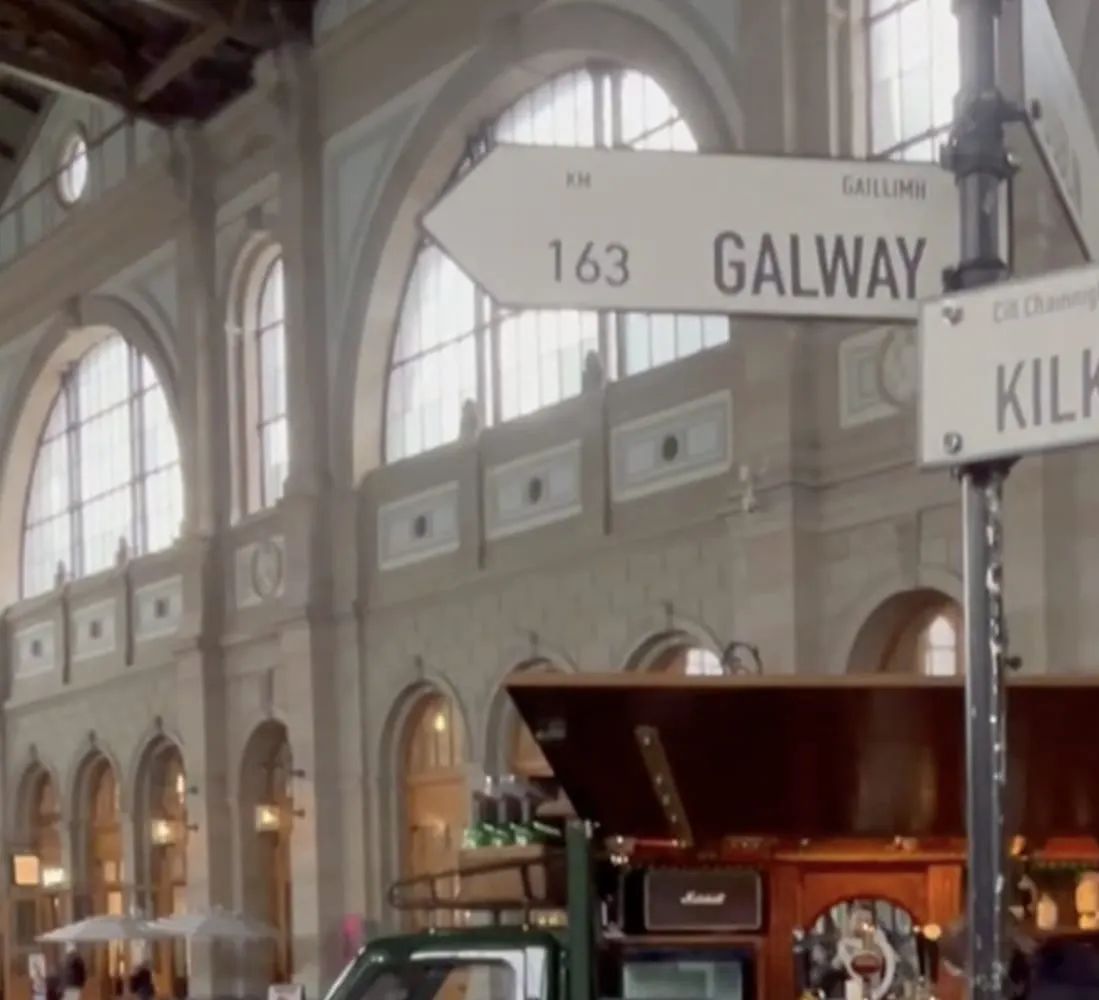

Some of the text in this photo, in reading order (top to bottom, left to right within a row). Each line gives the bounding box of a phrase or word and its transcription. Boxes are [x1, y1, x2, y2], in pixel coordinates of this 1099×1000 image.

[565, 170, 592, 190] KM
[842, 175, 927, 201] GAILLIMH
[547, 238, 630, 288] 163
[713, 231, 928, 300] GALWAY
